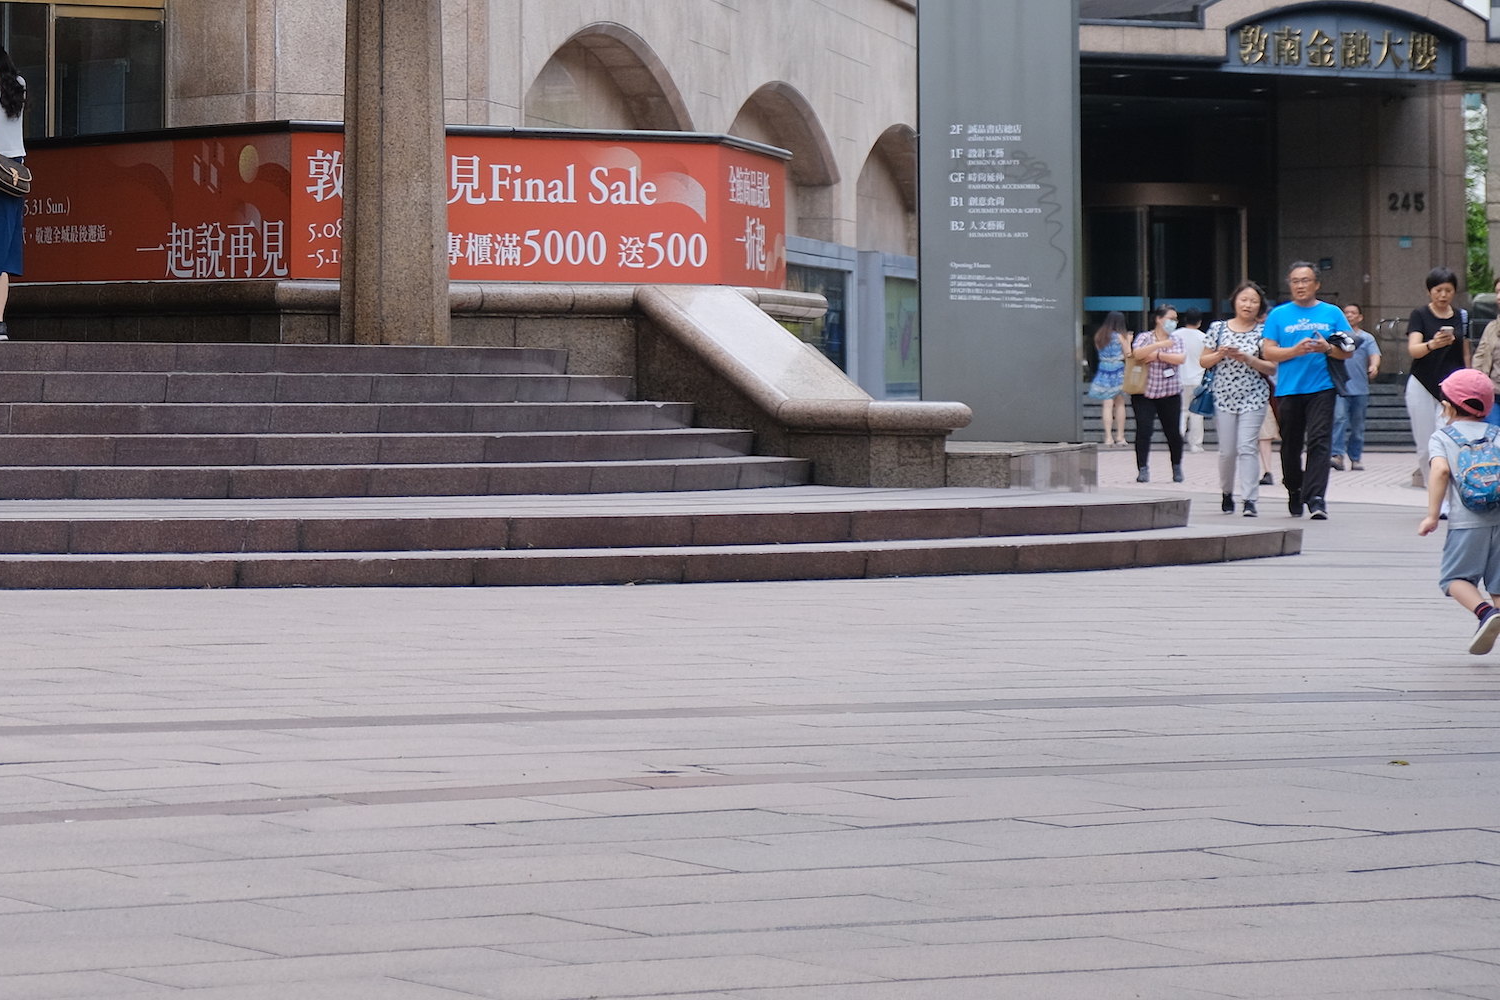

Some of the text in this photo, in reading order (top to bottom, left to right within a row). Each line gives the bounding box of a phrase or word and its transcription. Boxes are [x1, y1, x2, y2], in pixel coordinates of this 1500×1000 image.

[1239, 24, 1439, 72] 敦南金融大樓
[949, 124, 963, 134] 2F
[950, 148, 964, 159] 1F
[949, 172, 965, 183] GF
[588, 166, 657, 206] Sale
[950, 196, 964, 207] B1
[1388, 192, 1426, 212] 245
[950, 221, 1006, 231] B2 人文藝術
[136, 219, 289, 279] 一起說再見
[735, 215, 766, 271] 一折起
[307, 249, 341, 268] -5.1
[1284, 322, 1330, 334] eyeSmart
